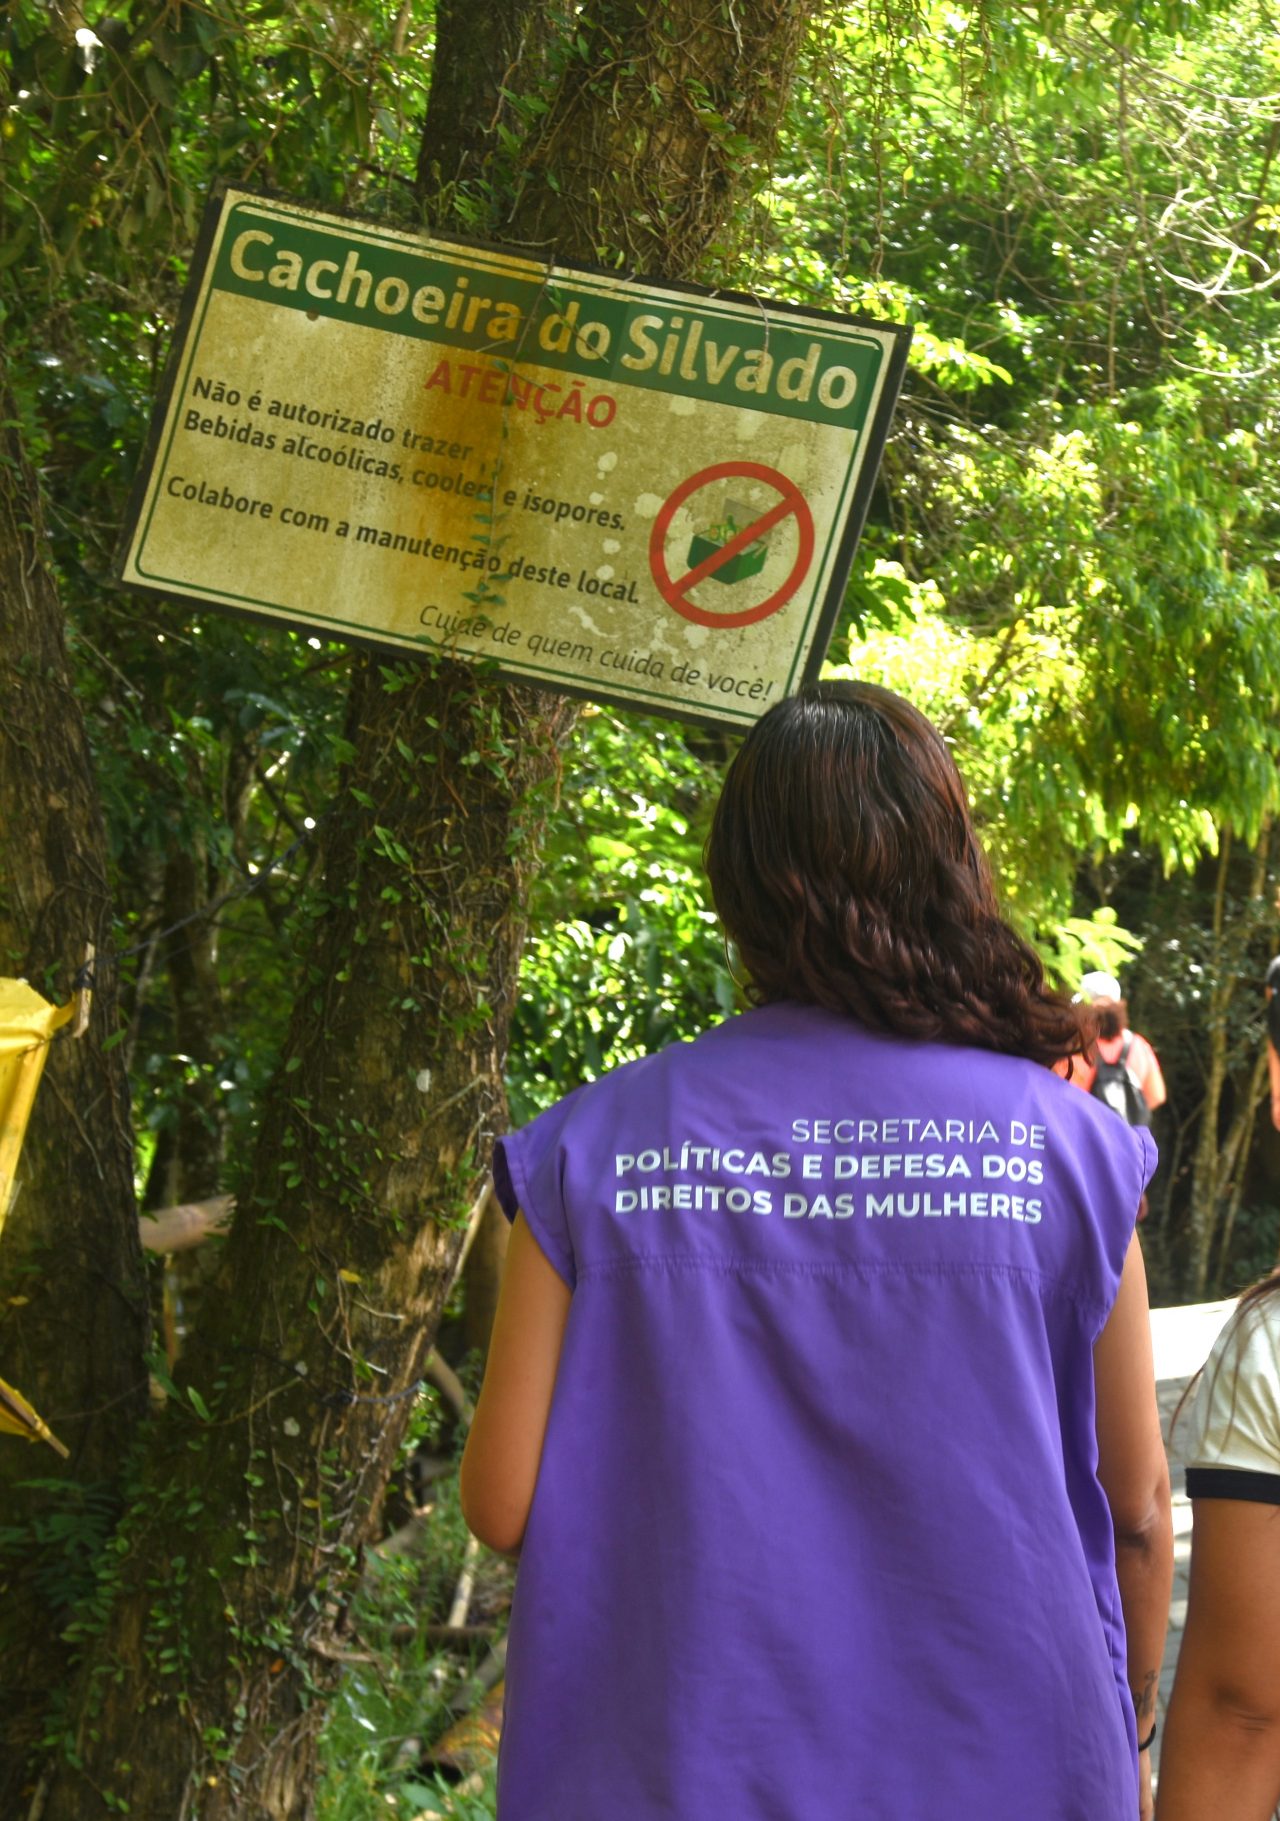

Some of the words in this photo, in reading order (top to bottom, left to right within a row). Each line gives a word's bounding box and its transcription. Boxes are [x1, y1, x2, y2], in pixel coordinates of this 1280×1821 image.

[229, 229, 522, 342] Cachoeira
[538, 300, 612, 361] do
[619, 314, 858, 409] Silvado
[191, 376, 241, 406] Não
[247, 389, 262, 411] é
[267, 400, 395, 444] autorizado
[402, 428, 474, 461] trazer
[424, 359, 617, 428] ATENÇÃO
[183, 409, 277, 450] Bebidas
[281, 435, 404, 484] alcoólicas,
[503, 488, 517, 507] e
[523, 487, 626, 532] isopores.
[167, 475, 274, 519] Colabore
[279, 507, 329, 532] com
[335, 521, 350, 538] a
[356, 525, 501, 572] manutenção
[507, 555, 571, 589] deste
[577, 569, 640, 604] local.
[491, 621, 521, 646] de
[527, 633, 593, 663] quem
[600, 647, 665, 680] cuida
[670, 663, 701, 687] de
[707, 674, 774, 702] você!
[615, 1139, 792, 1179] POLÍTICAS
[802, 1153, 823, 1180] E
[833, 1153, 973, 1180] DEFESA
[982, 1153, 1045, 1185] DOS
[790, 1118, 1000, 1144] SECRETARIA
[1010, 1119, 1047, 1151] DE
[615, 1184, 774, 1216] DIREITOS
[783, 1192, 855, 1220] DAS
[865, 1191, 1043, 1225] MULHERES
